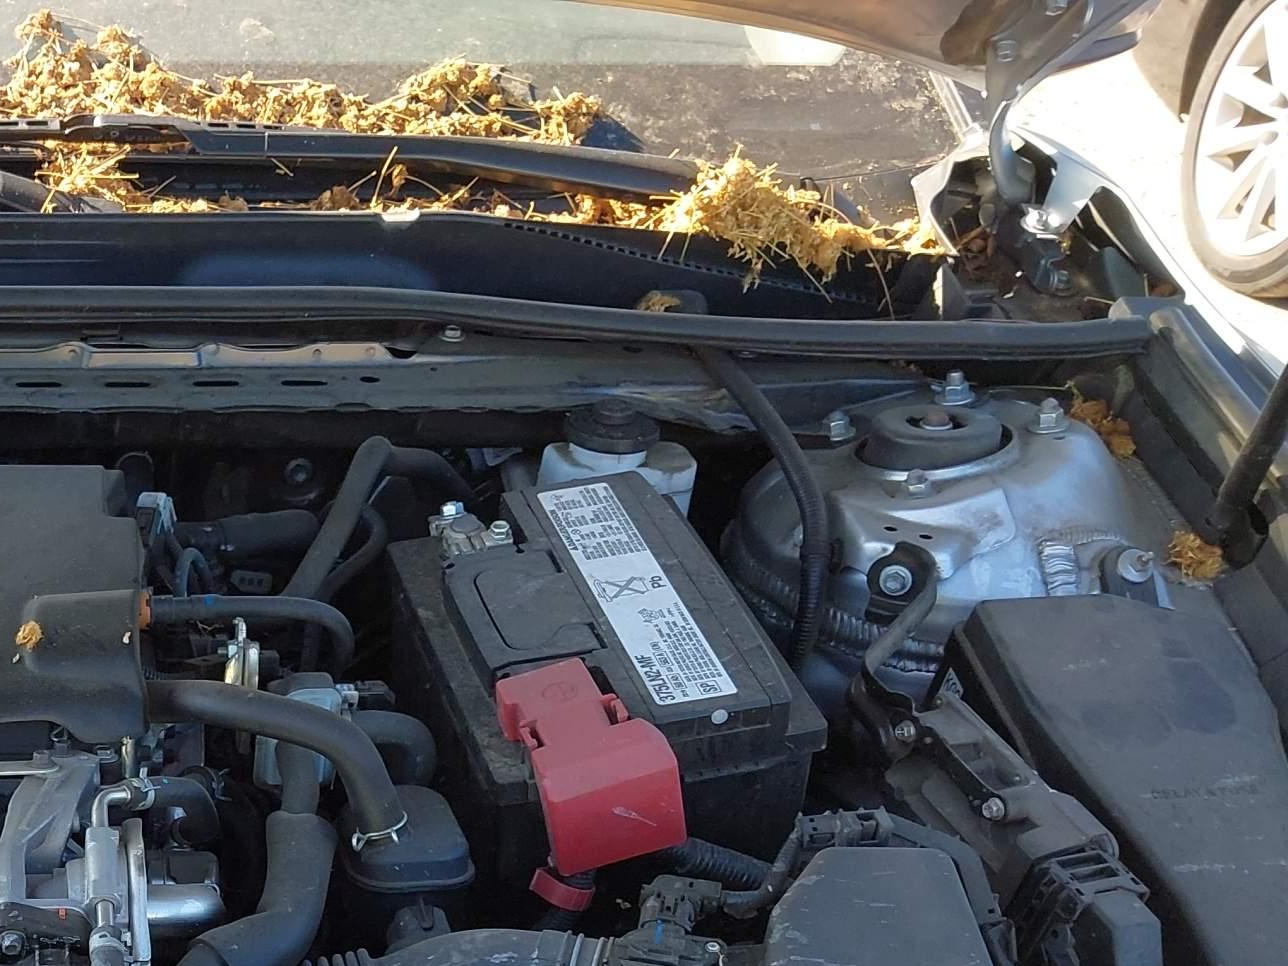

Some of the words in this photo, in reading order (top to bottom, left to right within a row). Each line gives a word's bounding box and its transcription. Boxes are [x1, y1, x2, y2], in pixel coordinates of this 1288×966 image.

[649, 575, 667, 589] Pb
[635, 654, 676, 702] 375LN2-MF
[699, 682, 718, 693] SP
